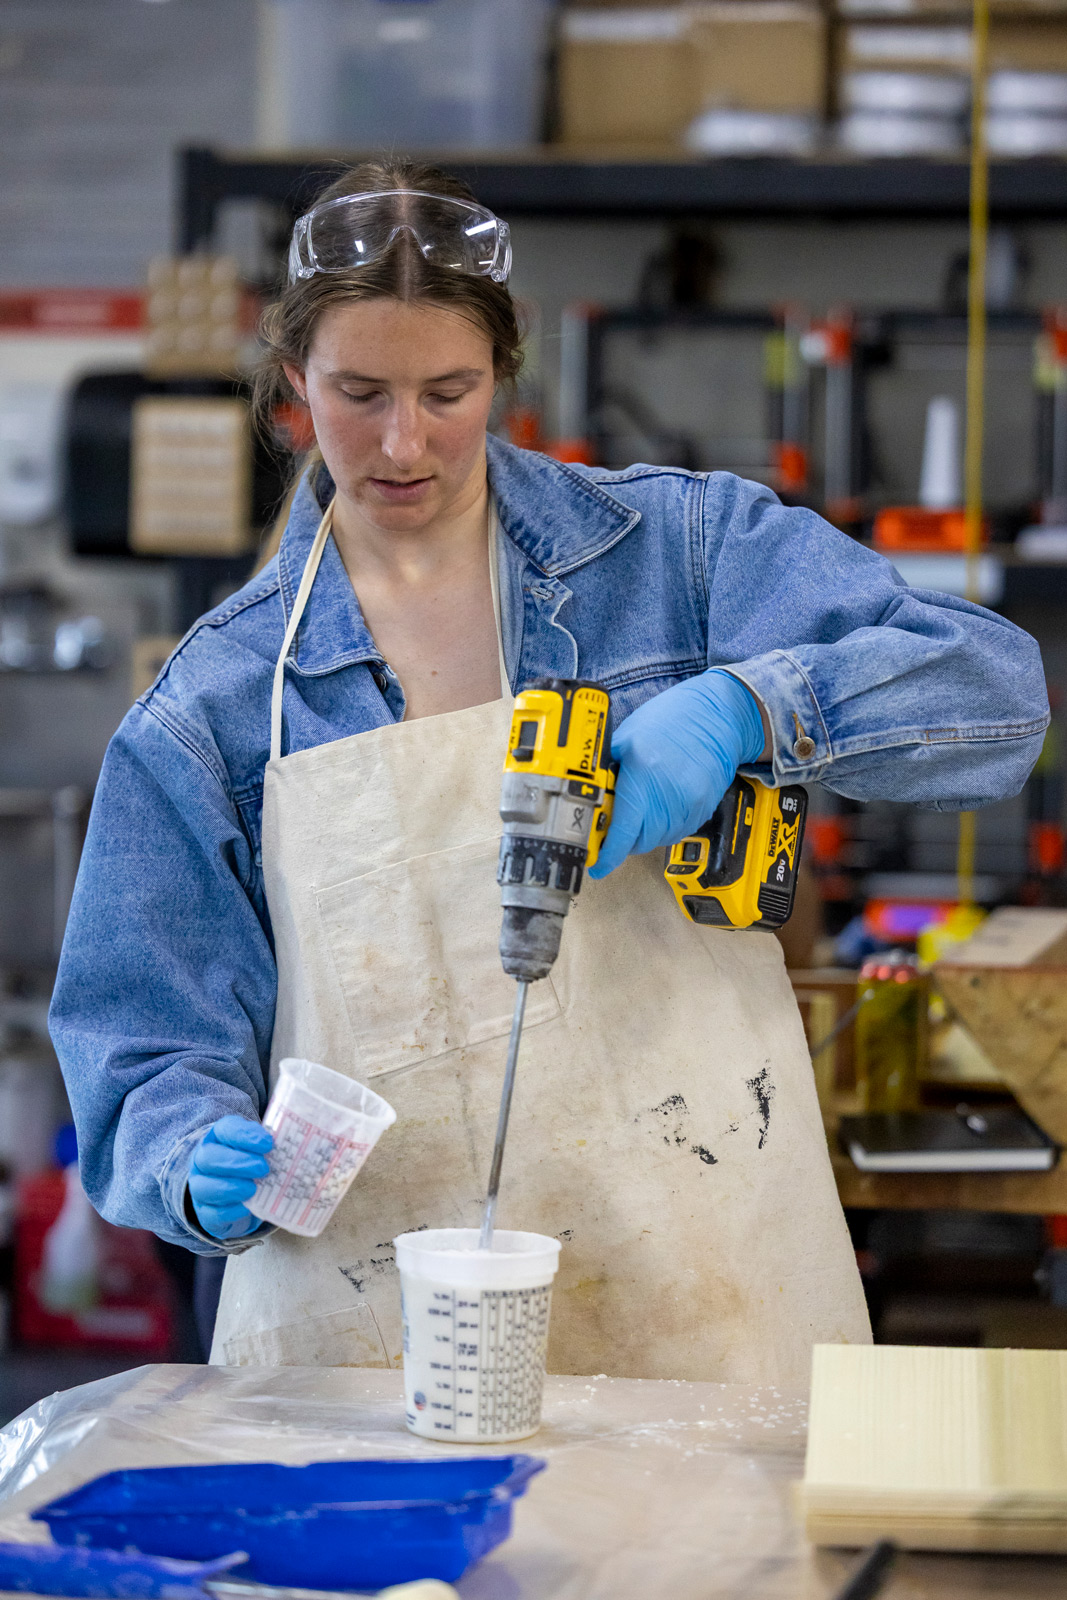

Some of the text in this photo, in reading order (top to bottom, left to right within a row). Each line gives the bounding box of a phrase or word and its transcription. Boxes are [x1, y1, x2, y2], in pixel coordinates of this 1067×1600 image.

[782, 797, 793, 811] 5
[571, 807, 585, 829] XR
[776, 820, 797, 860] XR
